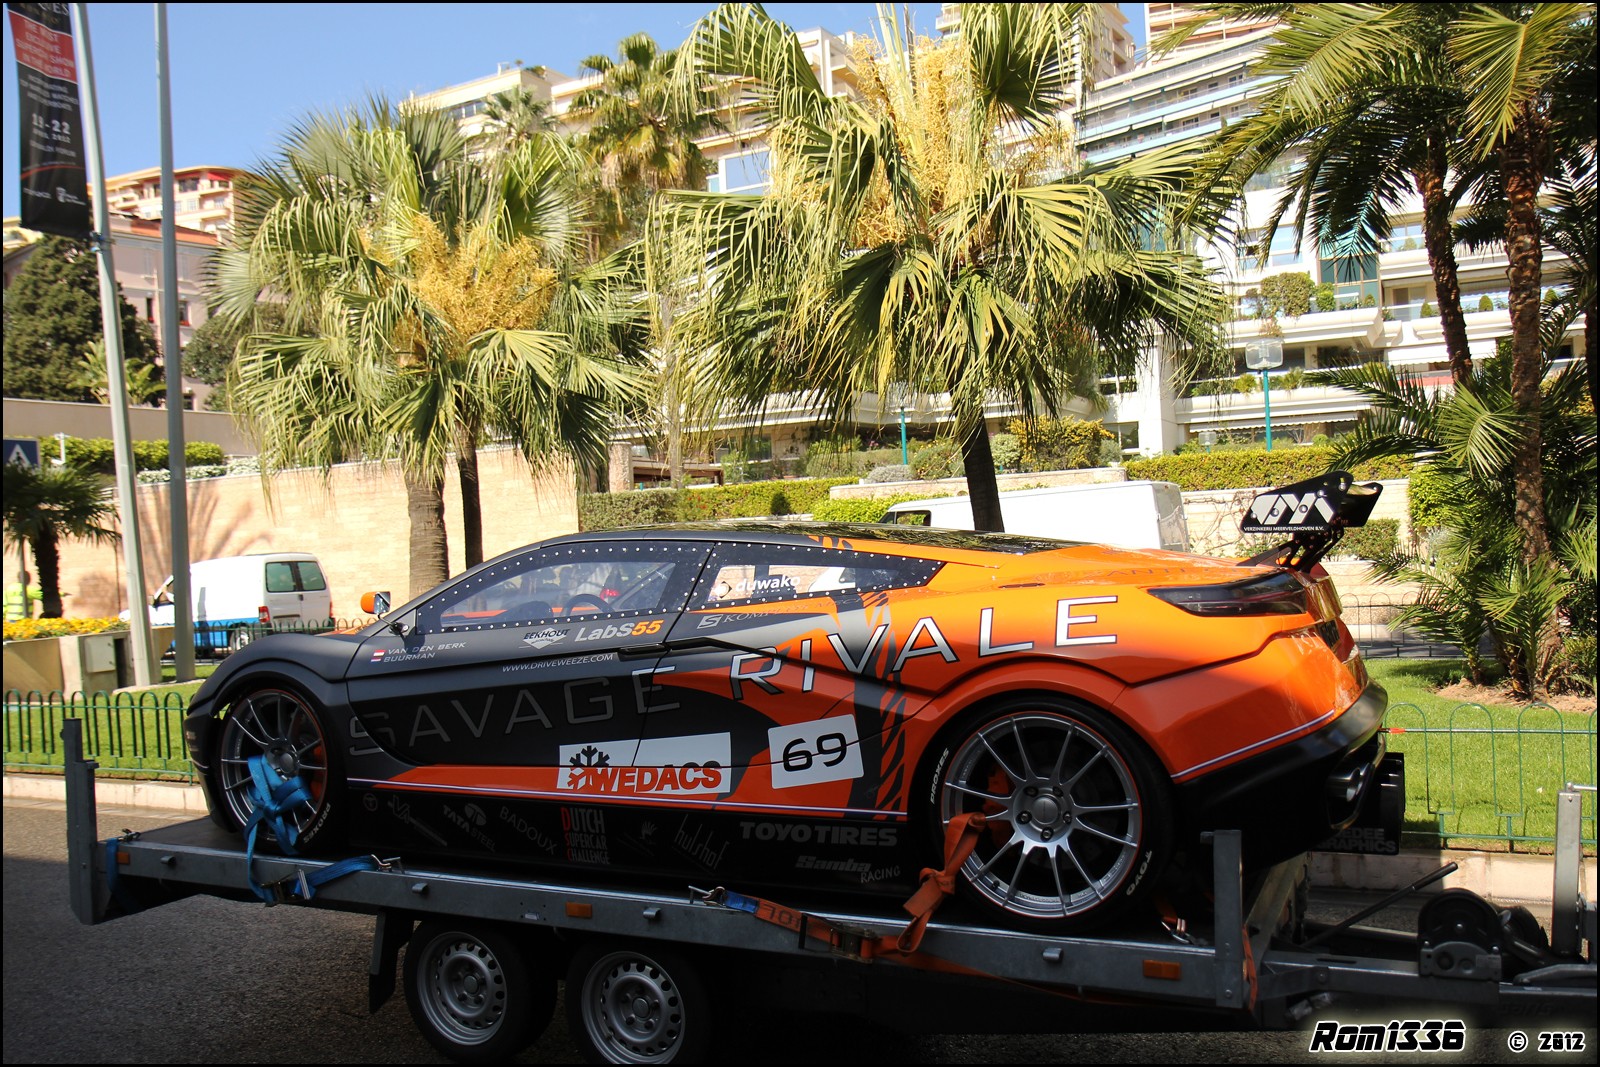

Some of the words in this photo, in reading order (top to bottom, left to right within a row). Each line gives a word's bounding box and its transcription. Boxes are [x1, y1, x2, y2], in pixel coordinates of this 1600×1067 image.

[735, 575, 801, 592] duwako
[524, 628, 571, 640] EEKHOUT
[574, 620, 664, 642] LabS55
[383, 652, 436, 662] BUURMAN
[412, 645, 434, 653] DEN
[438, 642, 466, 650] BERK
[502, 653, 613, 673] WWW.DRIVEWEEZE.COM
[349, 665, 680, 755] SAVAGE
[730, 595, 1118, 700] RIVALE
[782, 732, 847, 772] 69
[592, 761, 722, 792] WEDACS
[443, 804, 470, 833] TATA
[470, 827, 496, 853] STEEL
[499, 805, 558, 855] BADOUX
[560, 806, 605, 834] DUTCH
[564, 832, 608, 850] SUPERCAR
[739, 821, 813, 843] TOYO
[814, 824, 898, 847] TIRES
[1335, 827, 1384, 840] EDEE
[566, 849, 611, 864] CHALLENGE
[795, 855, 872, 873] Samba
[860, 865, 901, 884] RACING
[1126, 849, 1152, 896] TOYO
